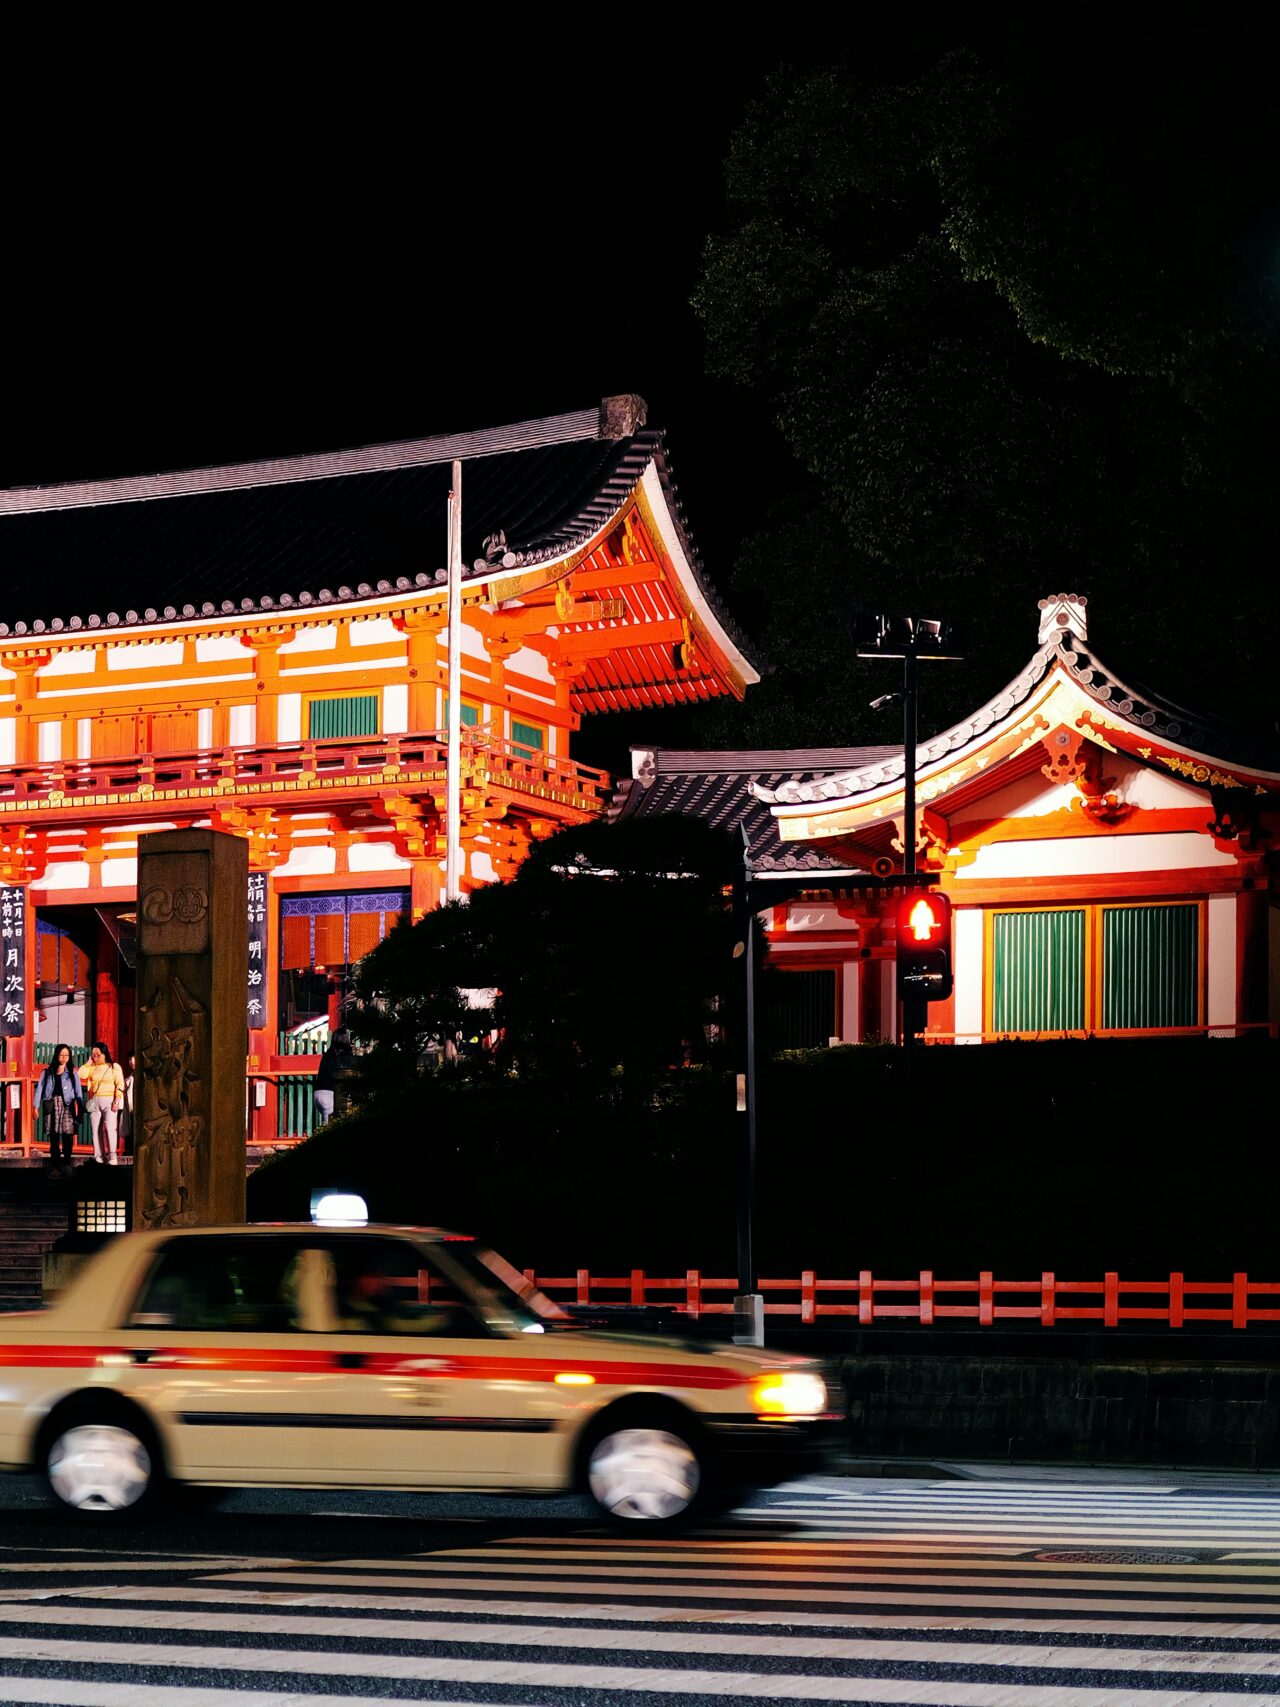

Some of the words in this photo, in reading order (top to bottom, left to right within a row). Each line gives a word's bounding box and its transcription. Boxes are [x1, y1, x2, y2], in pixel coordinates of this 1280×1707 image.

[0, 890, 13, 939] 午前十時
[13, 889, 24, 937] 十一月一日
[254, 873, 266, 922] 十一月三日
[2, 948, 24, 1023] 月次祭
[246, 940, 262, 1015] 明治祭
